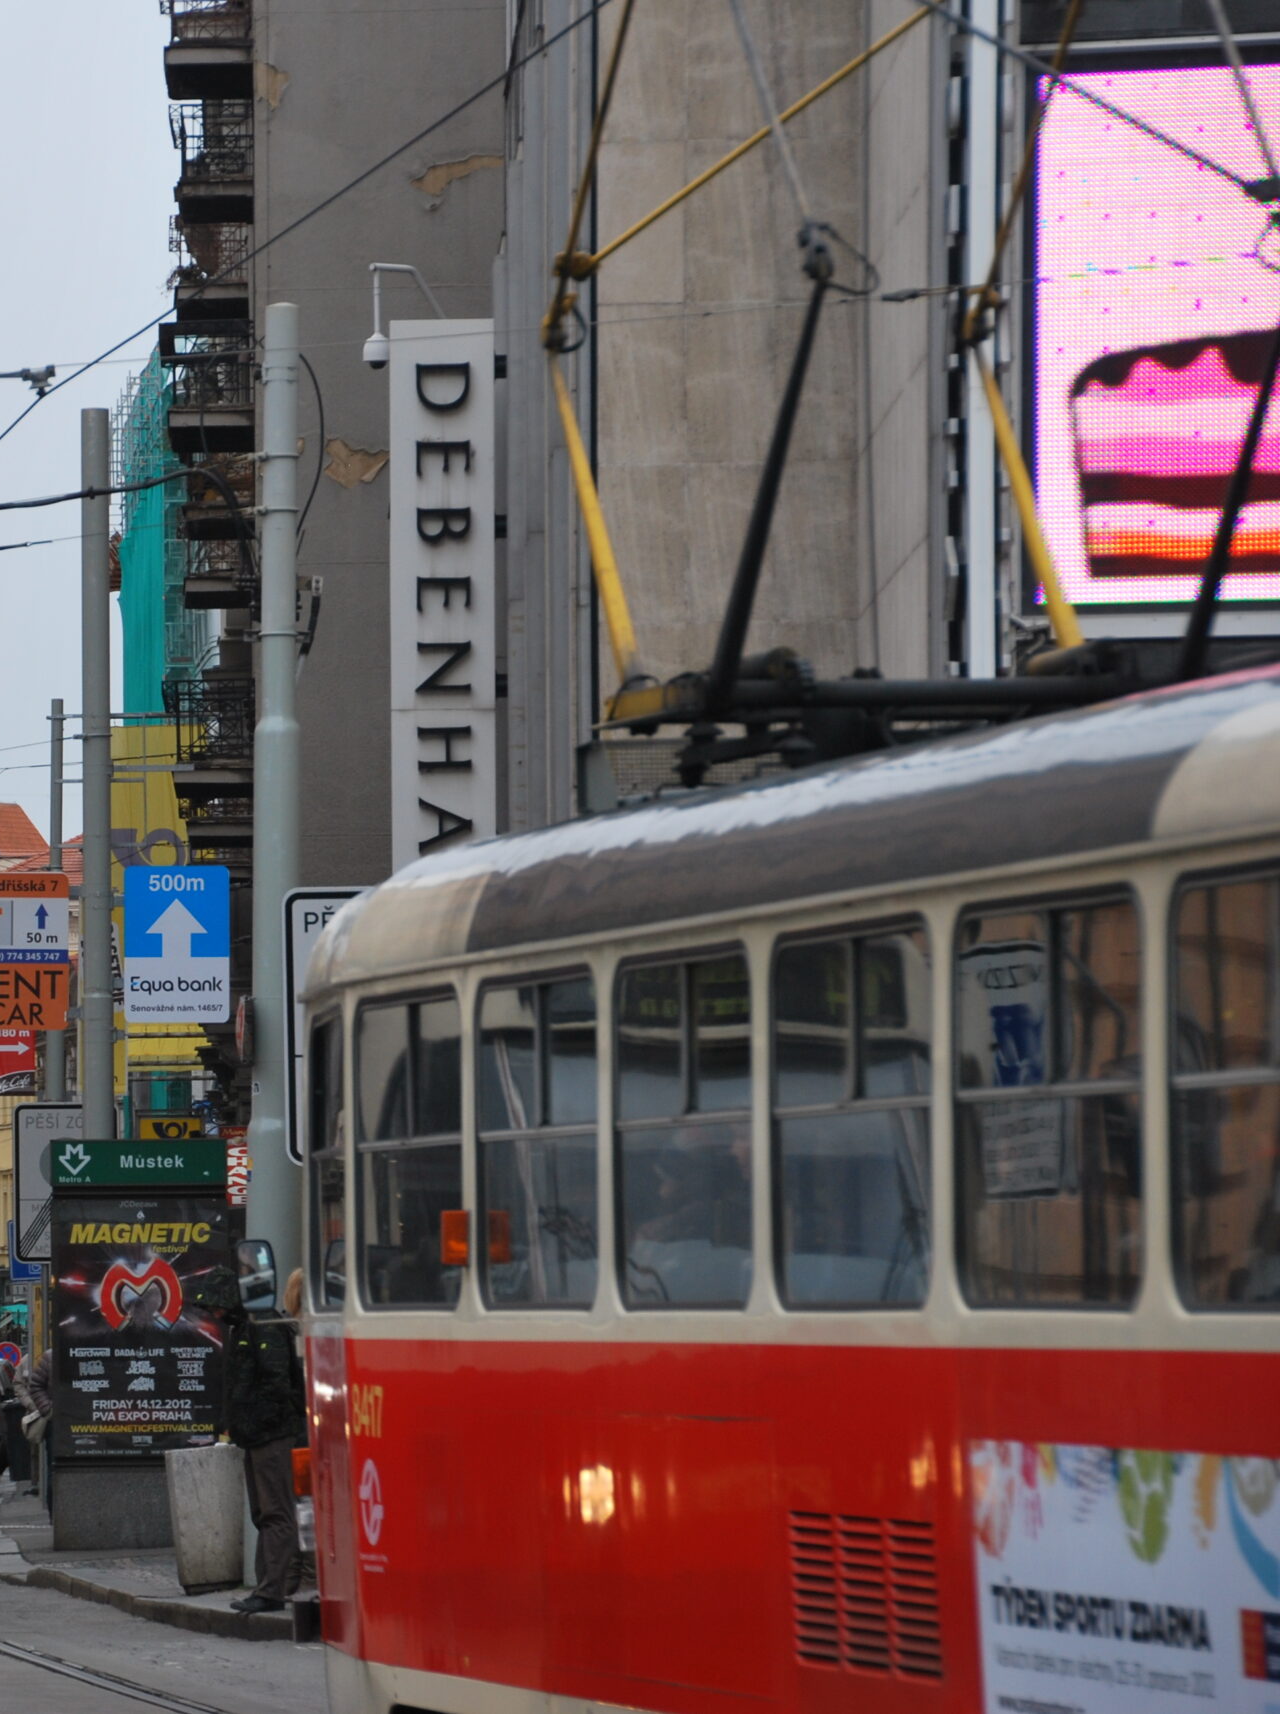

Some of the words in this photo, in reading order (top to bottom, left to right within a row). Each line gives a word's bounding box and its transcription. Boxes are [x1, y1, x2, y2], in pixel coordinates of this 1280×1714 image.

[51, 880, 59, 892] 7
[148, 874, 205, 892] 500m
[26, 932, 43, 944] 50
[46, 934, 59, 944] m
[6, 952, 24, 962] 774
[25, 952, 42, 962] 345
[43, 952, 60, 962] 747
[130, 976, 174, 995] Equa
[178, 976, 223, 992] bank
[130, 1004, 175, 1012] Senovážné
[198, 1004, 224, 1012] 1465/7
[25, 1112, 61, 1129] PĚŠÍ
[119, 1153, 185, 1169] Můstek
[69, 1222, 211, 1244] MAGNETIC
[152, 1245, 189, 1253] festival
[69, 1347, 111, 1357] Hardwell
[114, 1348, 136, 1357] DADA
[148, 1348, 165, 1357] LIFE
[92, 1400, 133, 1410] FRIDAY
[136, 1399, 192, 1410] 14.12.2012
[92, 1411, 116, 1421] PVA
[118, 1411, 150, 1421] EXPO
[152, 1411, 193, 1421] PRAHA
[352, 1384, 384, 1438] 8417
[70, 1424, 214, 1433] WWW.MAGNETICFESTIVAL.COM
[990, 1576, 1050, 1630] TÝDEN
[1053, 1591, 1125, 1641] SPORTU
[1129, 1601, 1213, 1653] ZDARMA
